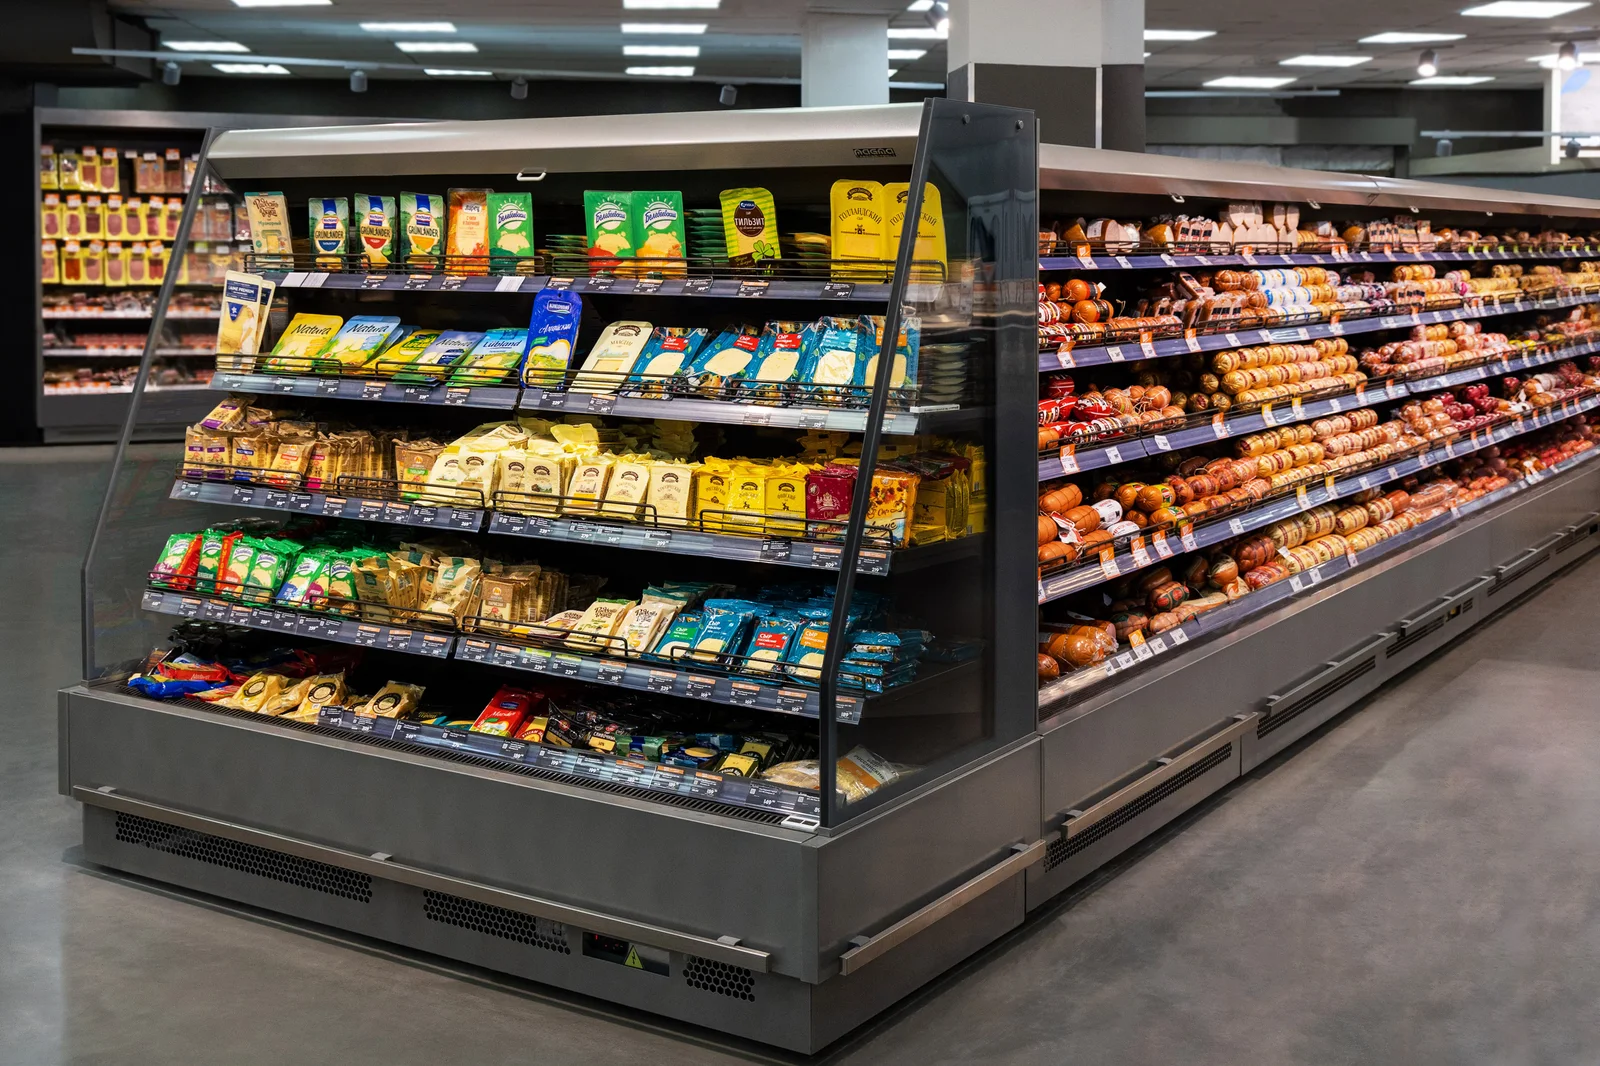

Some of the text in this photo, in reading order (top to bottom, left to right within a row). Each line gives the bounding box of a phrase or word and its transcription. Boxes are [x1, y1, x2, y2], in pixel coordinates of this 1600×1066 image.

[838, 207, 882, 225] ГОЛЛАНДСКИЙ
[735, 217, 765, 227] ТИЛЬЗИТ
[291, 324, 332, 336] Natura
[346, 324, 389, 335] Natura
[483, 340, 522, 349] Lübland
